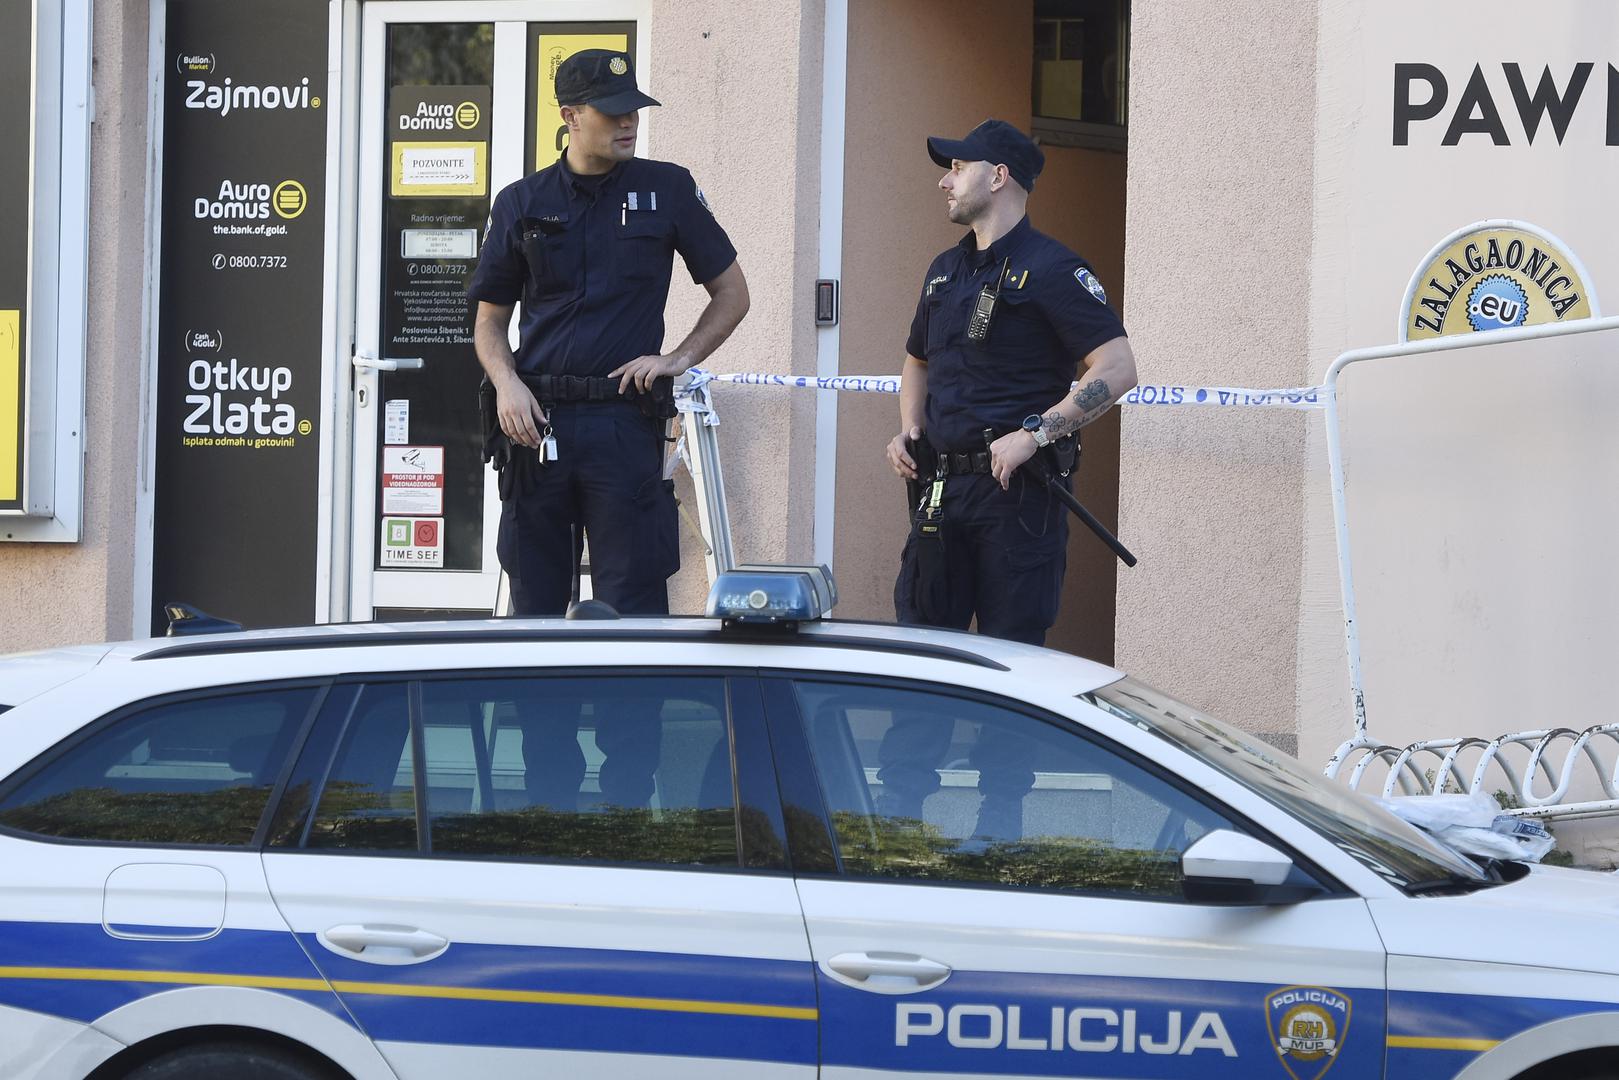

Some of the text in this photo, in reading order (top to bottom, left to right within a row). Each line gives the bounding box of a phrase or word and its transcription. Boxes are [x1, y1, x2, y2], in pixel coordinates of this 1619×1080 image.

[549, 56, 557, 81] Money
[185, 77, 309, 117] Zajmovi
[1392, 61, 1619, 147] PAW
[416, 101, 454, 117] Auro
[399, 114, 454, 130] Domus
[412, 158, 465, 168] POZVONITE
[218, 179, 271, 201] Auro
[194, 198, 270, 219] Domus
[410, 214, 465, 224] Radno vrijeme:
[213, 225, 288, 237] the.bank.of.gold.
[229, 255, 287, 268] 0800.7372
[420, 264, 467, 275] 0800.7372
[1414, 238, 1580, 334] ZALAGAONICA
[401, 326, 438, 335] Poslovnica
[438, 325, 464, 335] Šibenik
[392, 335, 409, 343] Ante
[446, 336, 452, 344] 3,
[453, 334, 474, 344] Šibeni
[188, 358, 292, 400] Otkup
[1126, 385, 1185, 405] STOP
[183, 392, 296, 435] Zlata
[183, 437, 295, 449] Isplata odmah u gotovini!
[385, 549, 439, 560] TIME SEF
[1272, 991, 1346, 1012] POLICIJA
[895, 1002, 1239, 1058] POLICIJA
[1291, 1040, 1324, 1050] MUP
